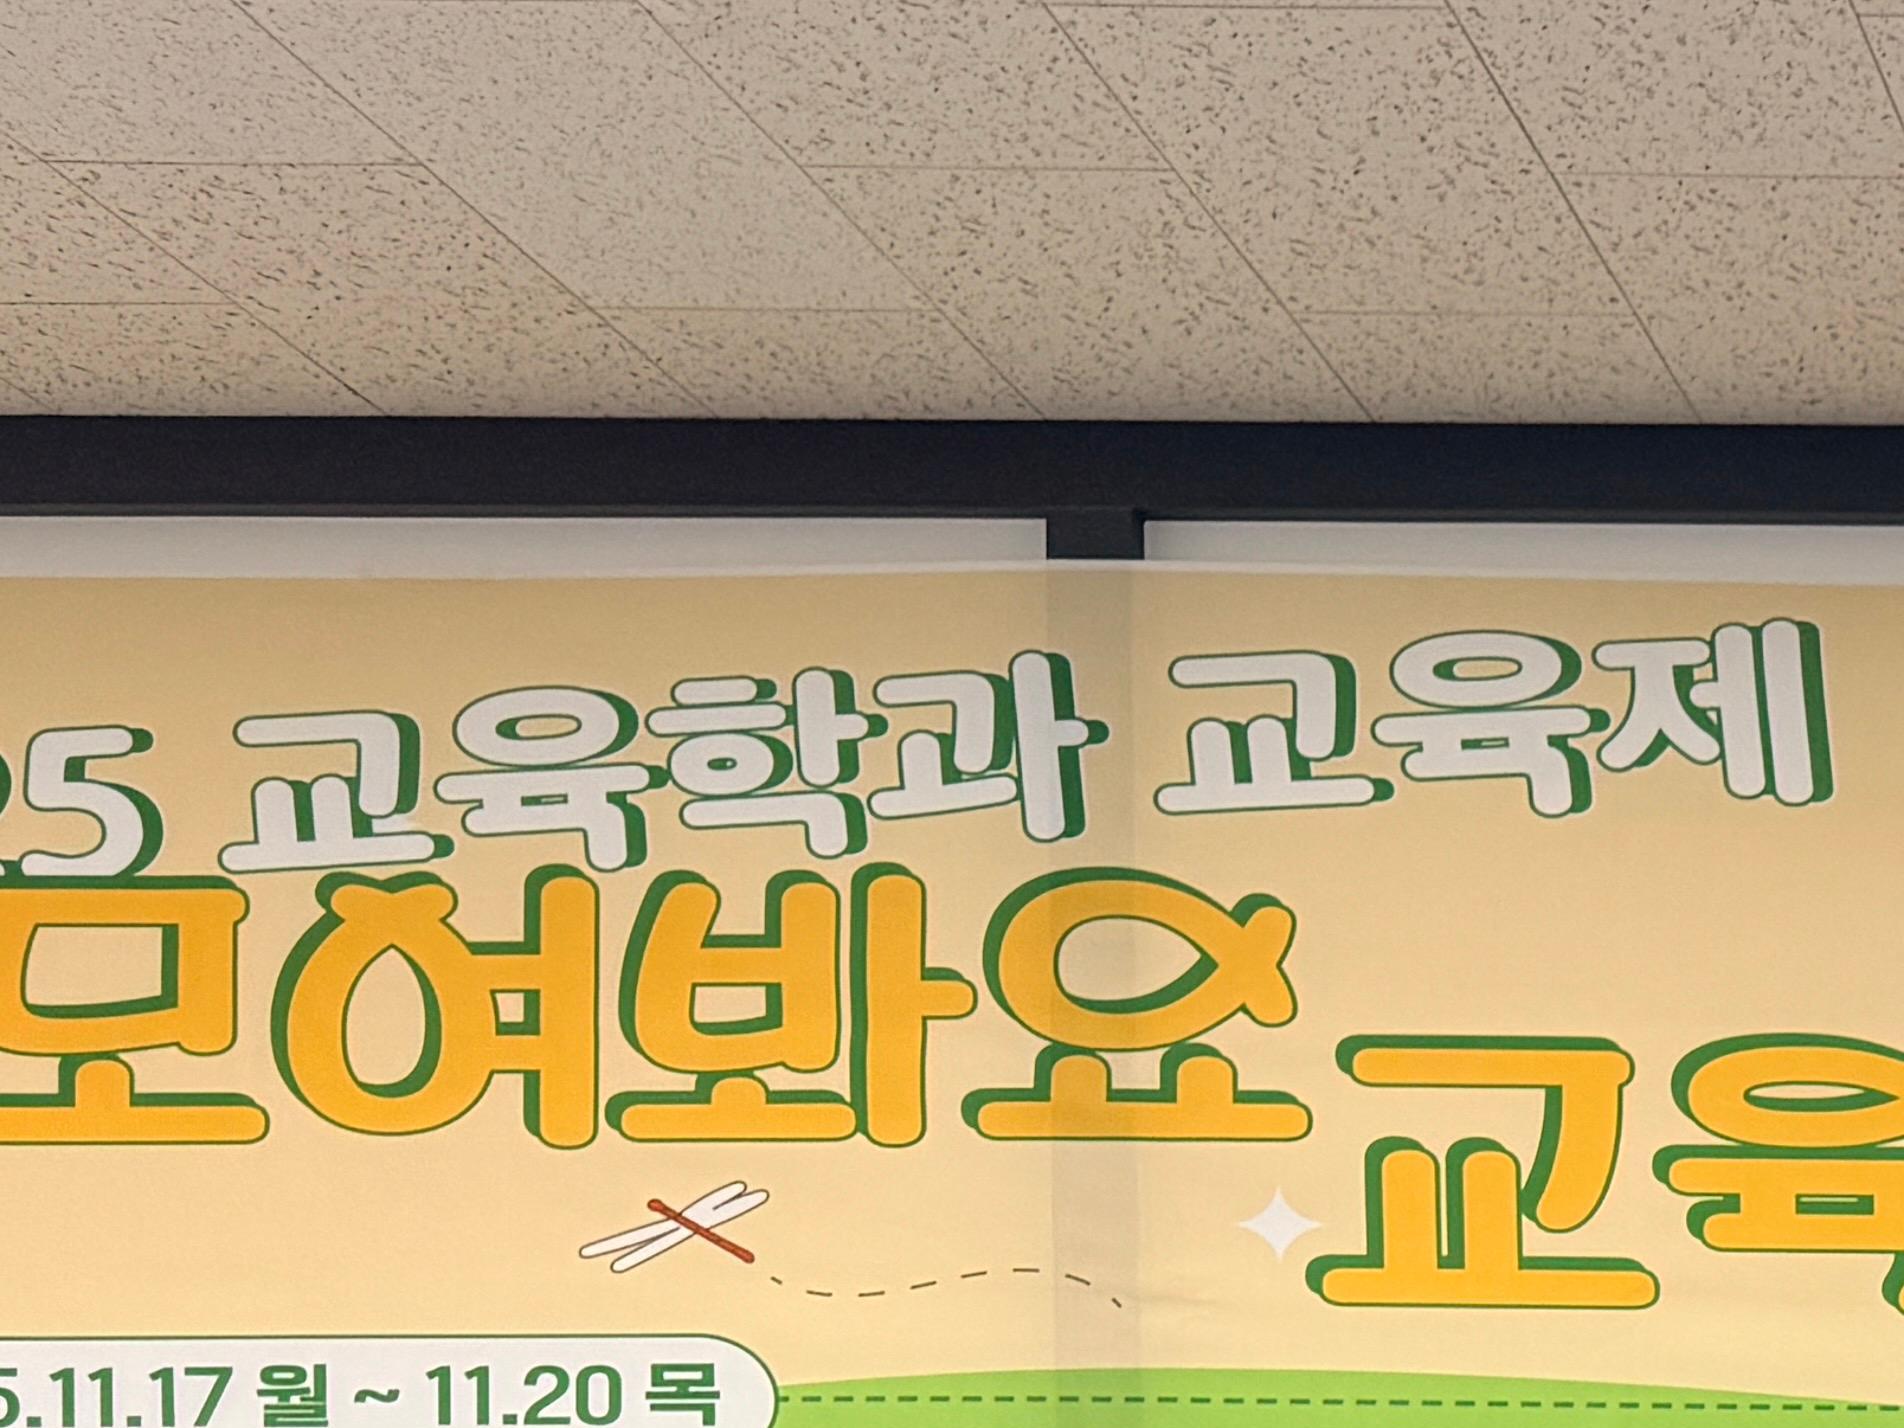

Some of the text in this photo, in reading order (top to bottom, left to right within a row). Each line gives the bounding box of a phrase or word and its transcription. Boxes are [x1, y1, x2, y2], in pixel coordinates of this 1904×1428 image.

[219, 648, 1110, 872] 교육학과
[1154, 617, 1834, 818] 교육제
[0, 863, 1313, 1149] 모여봐요
[354, 1384, 402, 1407] ~
[424, 1363, 623, 1425] 11.20
[643, 1362, 721, 1428] 목
